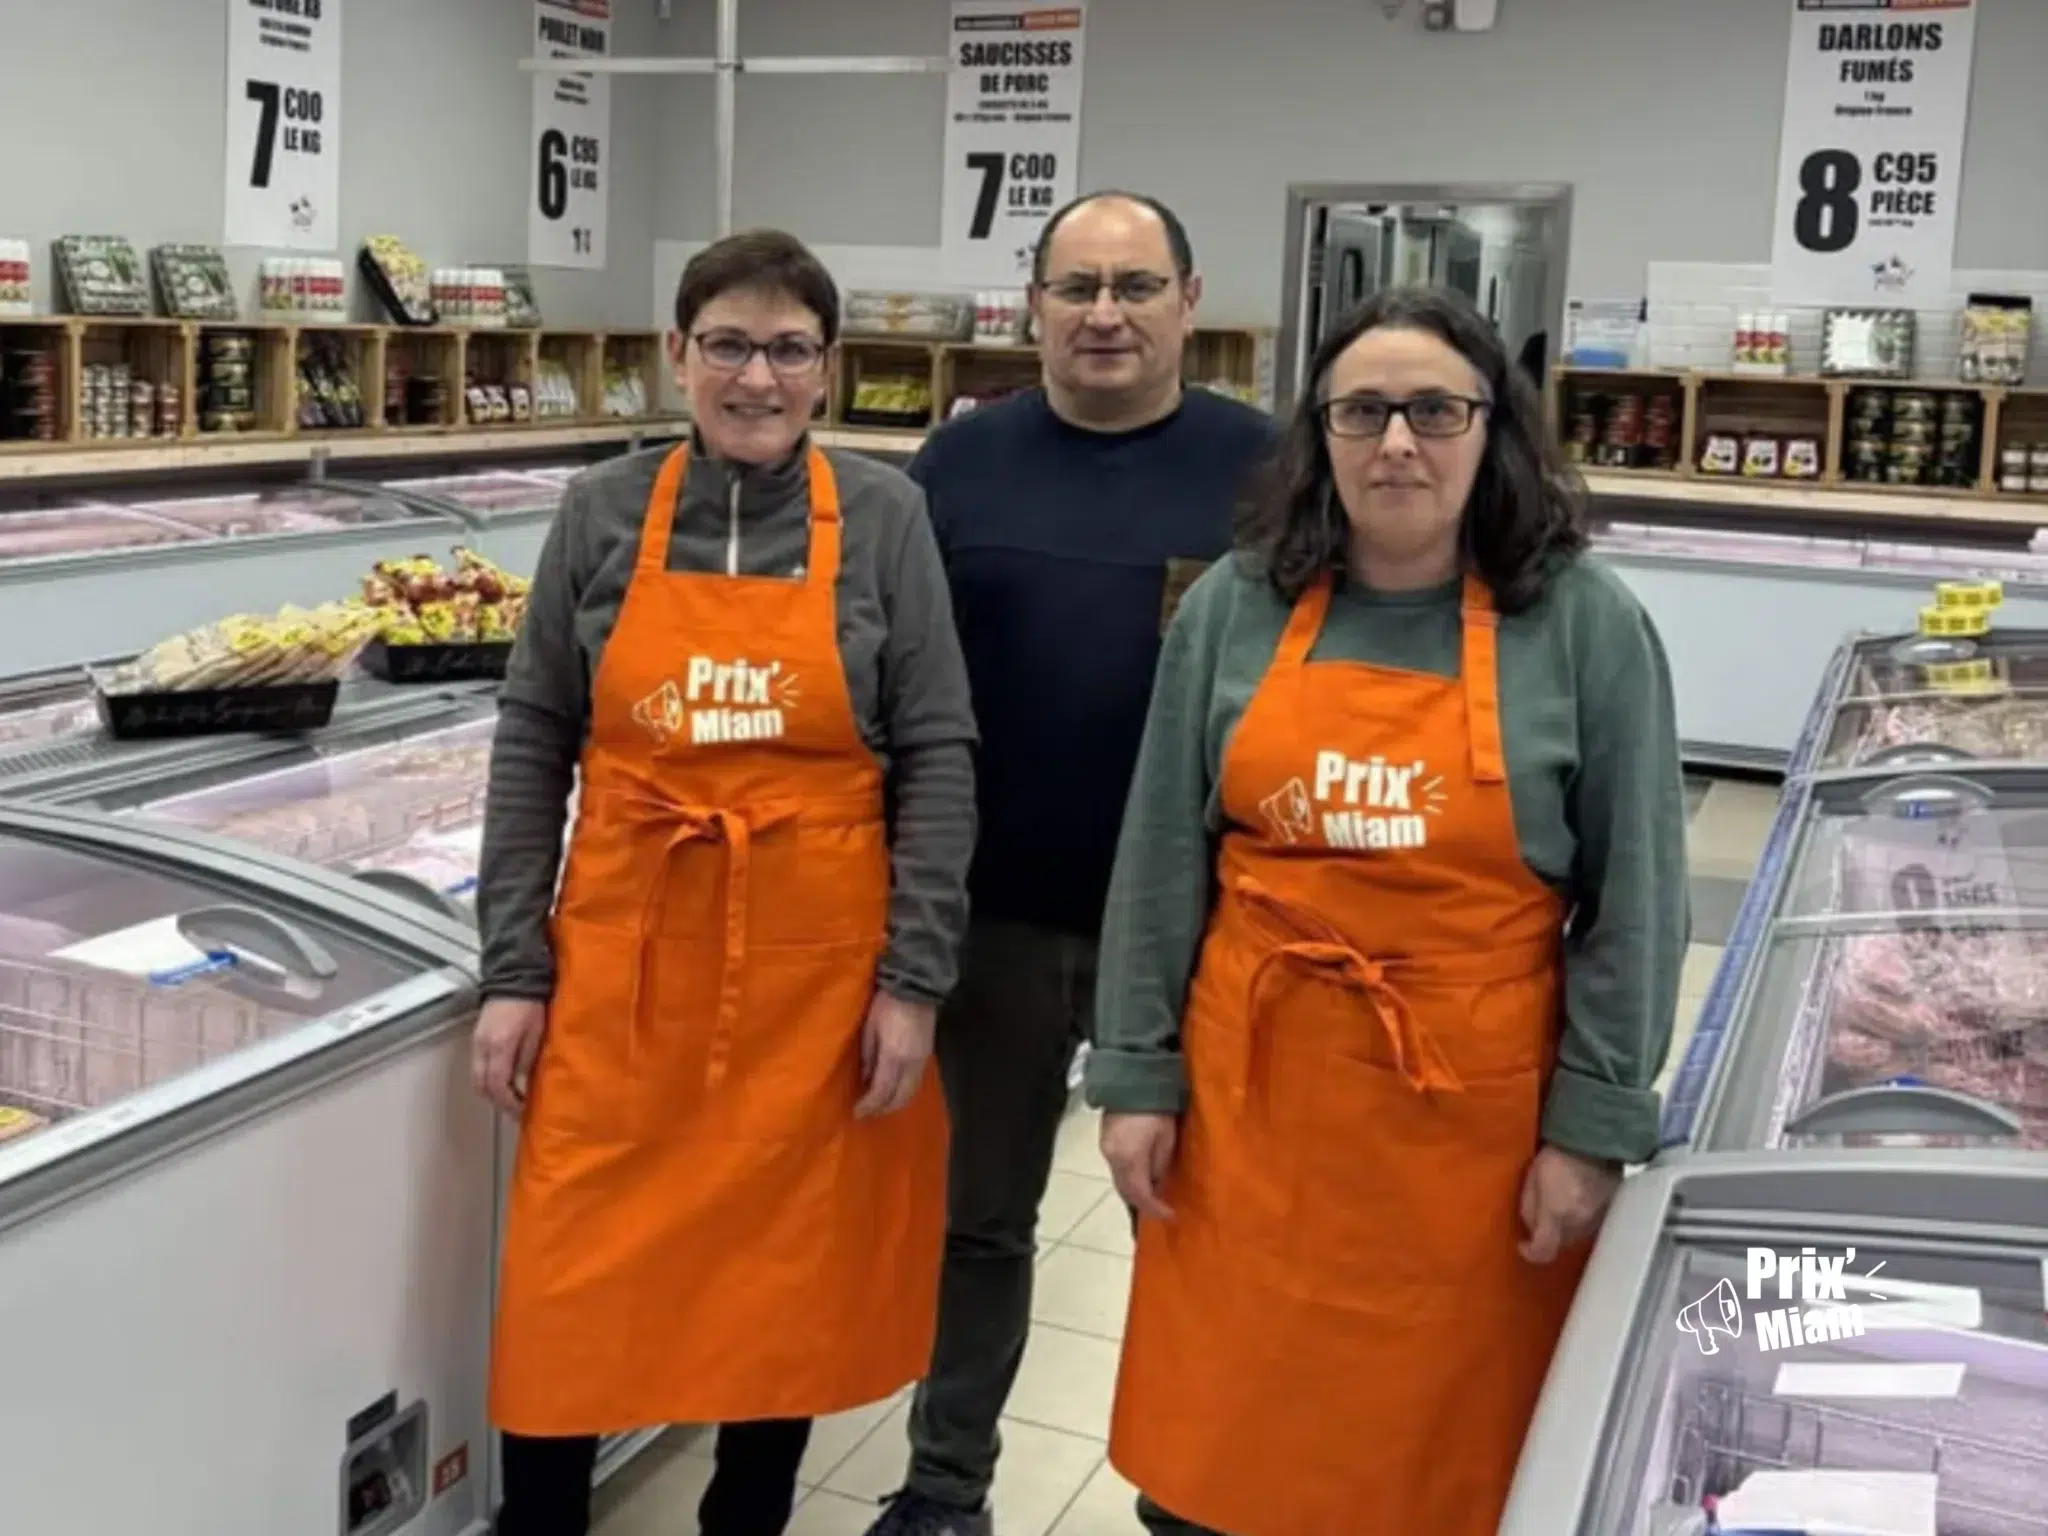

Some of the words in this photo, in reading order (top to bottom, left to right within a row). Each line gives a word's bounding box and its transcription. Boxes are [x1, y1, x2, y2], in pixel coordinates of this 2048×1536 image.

[960, 41, 1073, 67] SAUCISSES
[1818, 22, 1943, 51] DARLONS
[980, 74, 999, 94] DE
[1003, 73, 1050, 94] PORC
[1840, 57, 1914, 83] FUMÉS
[246, 80, 280, 188] 7
[284, 126, 298, 150] LE
[300, 129, 322, 154] KG
[538, 129, 568, 220] 6
[967, 153, 1006, 239] 7
[1008, 186, 1025, 206] LE
[1029, 186, 1053, 207] KG
[1794, 149, 1862, 253] 8
[1870, 188, 1935, 214] PIÈCE
[686, 656, 781, 705] Prix'
[691, 707, 784, 744] Miam
[1314, 750, 1425, 811] Prix'
[1322, 811, 1427, 849] Miam
